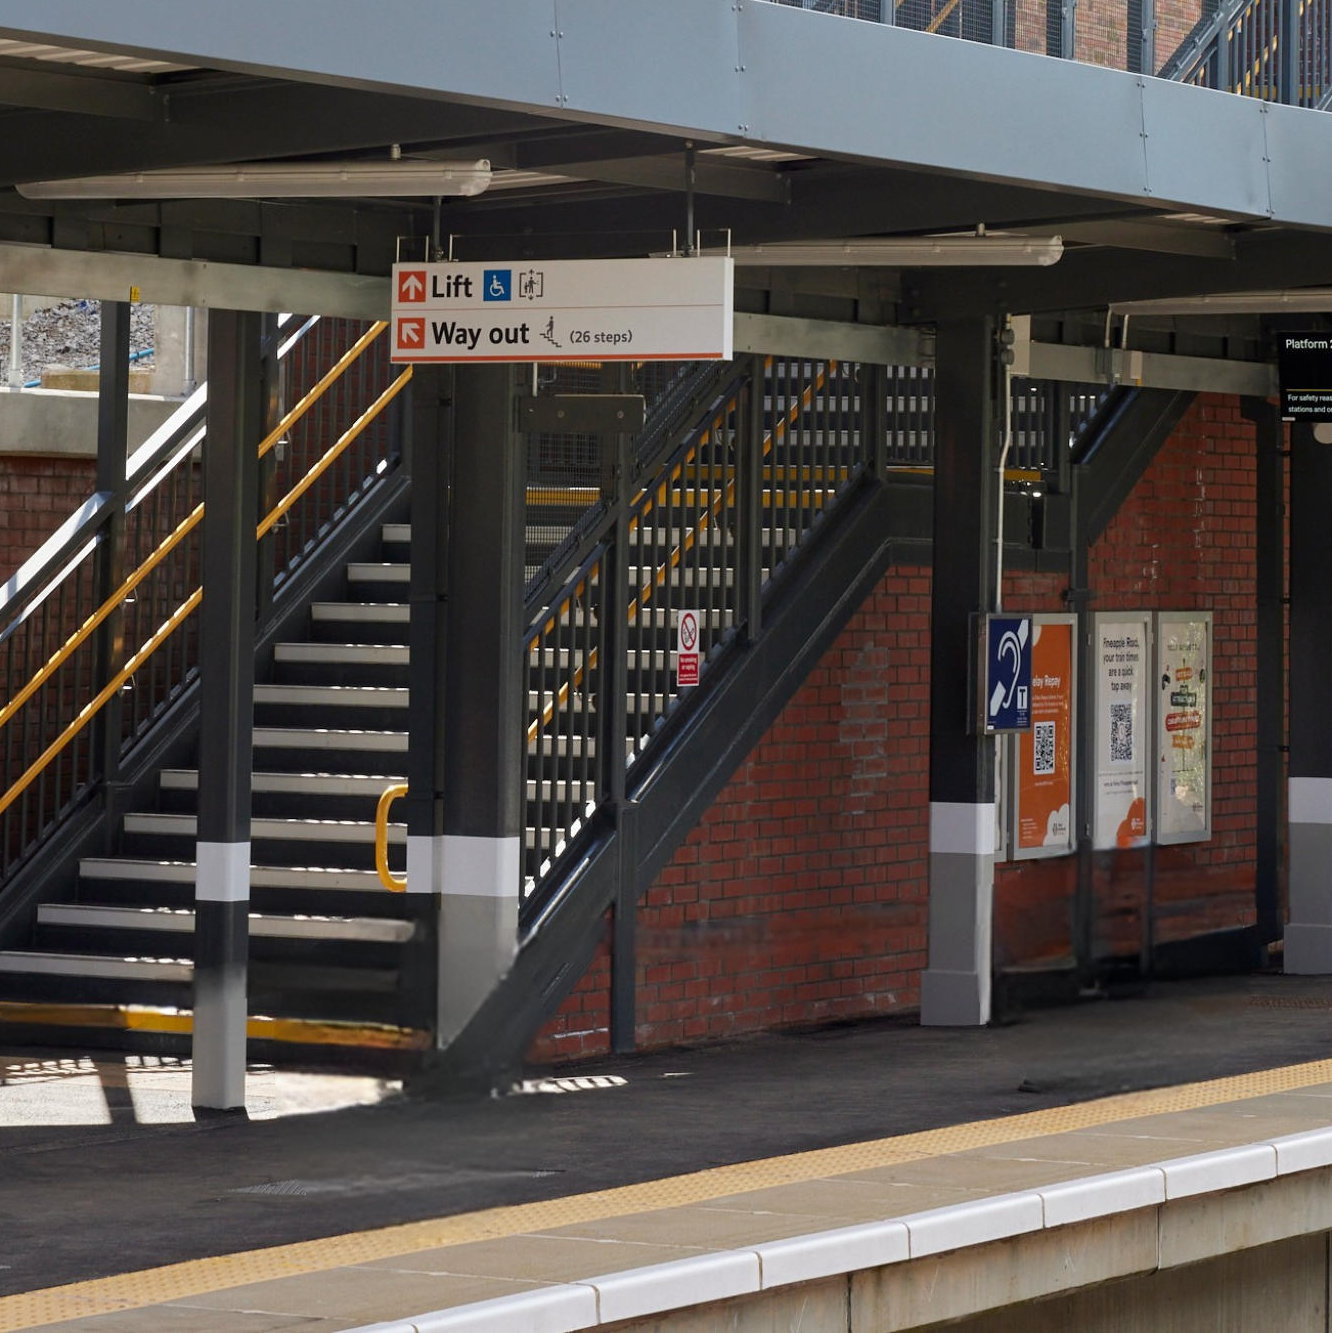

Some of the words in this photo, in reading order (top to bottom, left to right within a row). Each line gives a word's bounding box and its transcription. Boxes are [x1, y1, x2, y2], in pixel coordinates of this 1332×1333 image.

[431, 275, 472, 298] Lift
[432, 321, 482, 350] Way
[489, 323, 529, 345] out
[569, 330, 590, 345] (26
[594, 329, 634, 346] steps)
[1285, 339, 1328, 349] Platform
[1287, 394, 1299, 402] For
[1299, 394, 1319, 403] safety
[1103, 654, 1114, 665] your
[1115, 651, 1125, 662] train
[1126, 651, 1139, 662] times
[1108, 668, 1117, 676] are
[1122, 665, 1133, 678] quick
[1032, 675, 1044, 689] elay
[1044, 675, 1061, 689] Repay
[1111, 681, 1119, 693] tap
[1120, 682, 1132, 693] away
[1019, 688, 1026, 708] T
